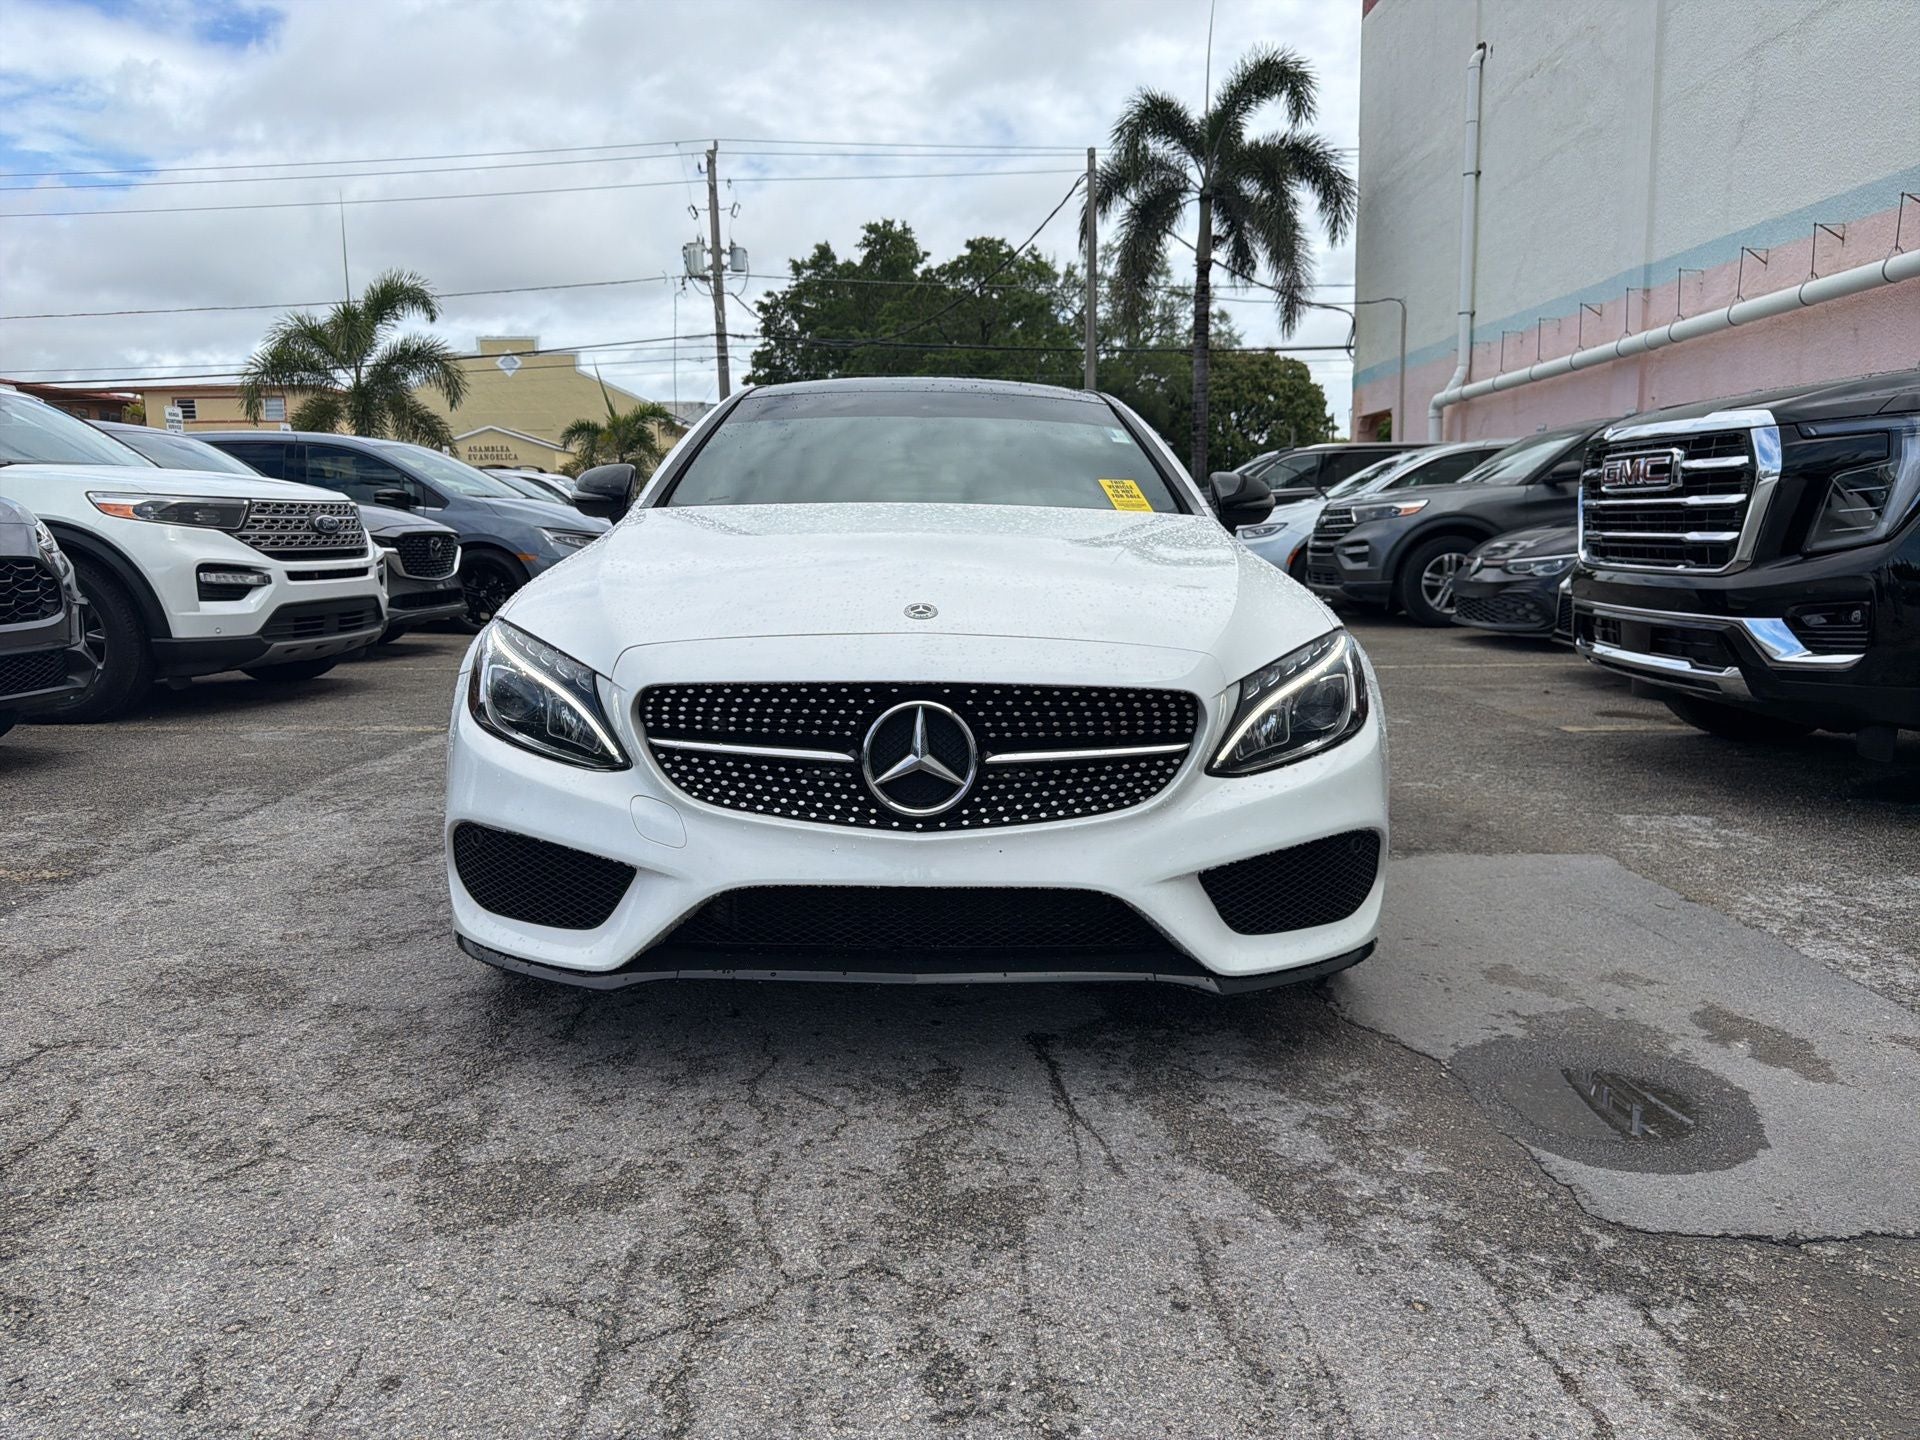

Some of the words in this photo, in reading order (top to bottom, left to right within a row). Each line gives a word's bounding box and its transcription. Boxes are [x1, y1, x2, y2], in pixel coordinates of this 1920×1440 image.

[468, 445, 511, 453] ASAMBLEA
[468, 453, 519, 461] EVANGELICA
[1603, 456, 1672, 487] GMC
